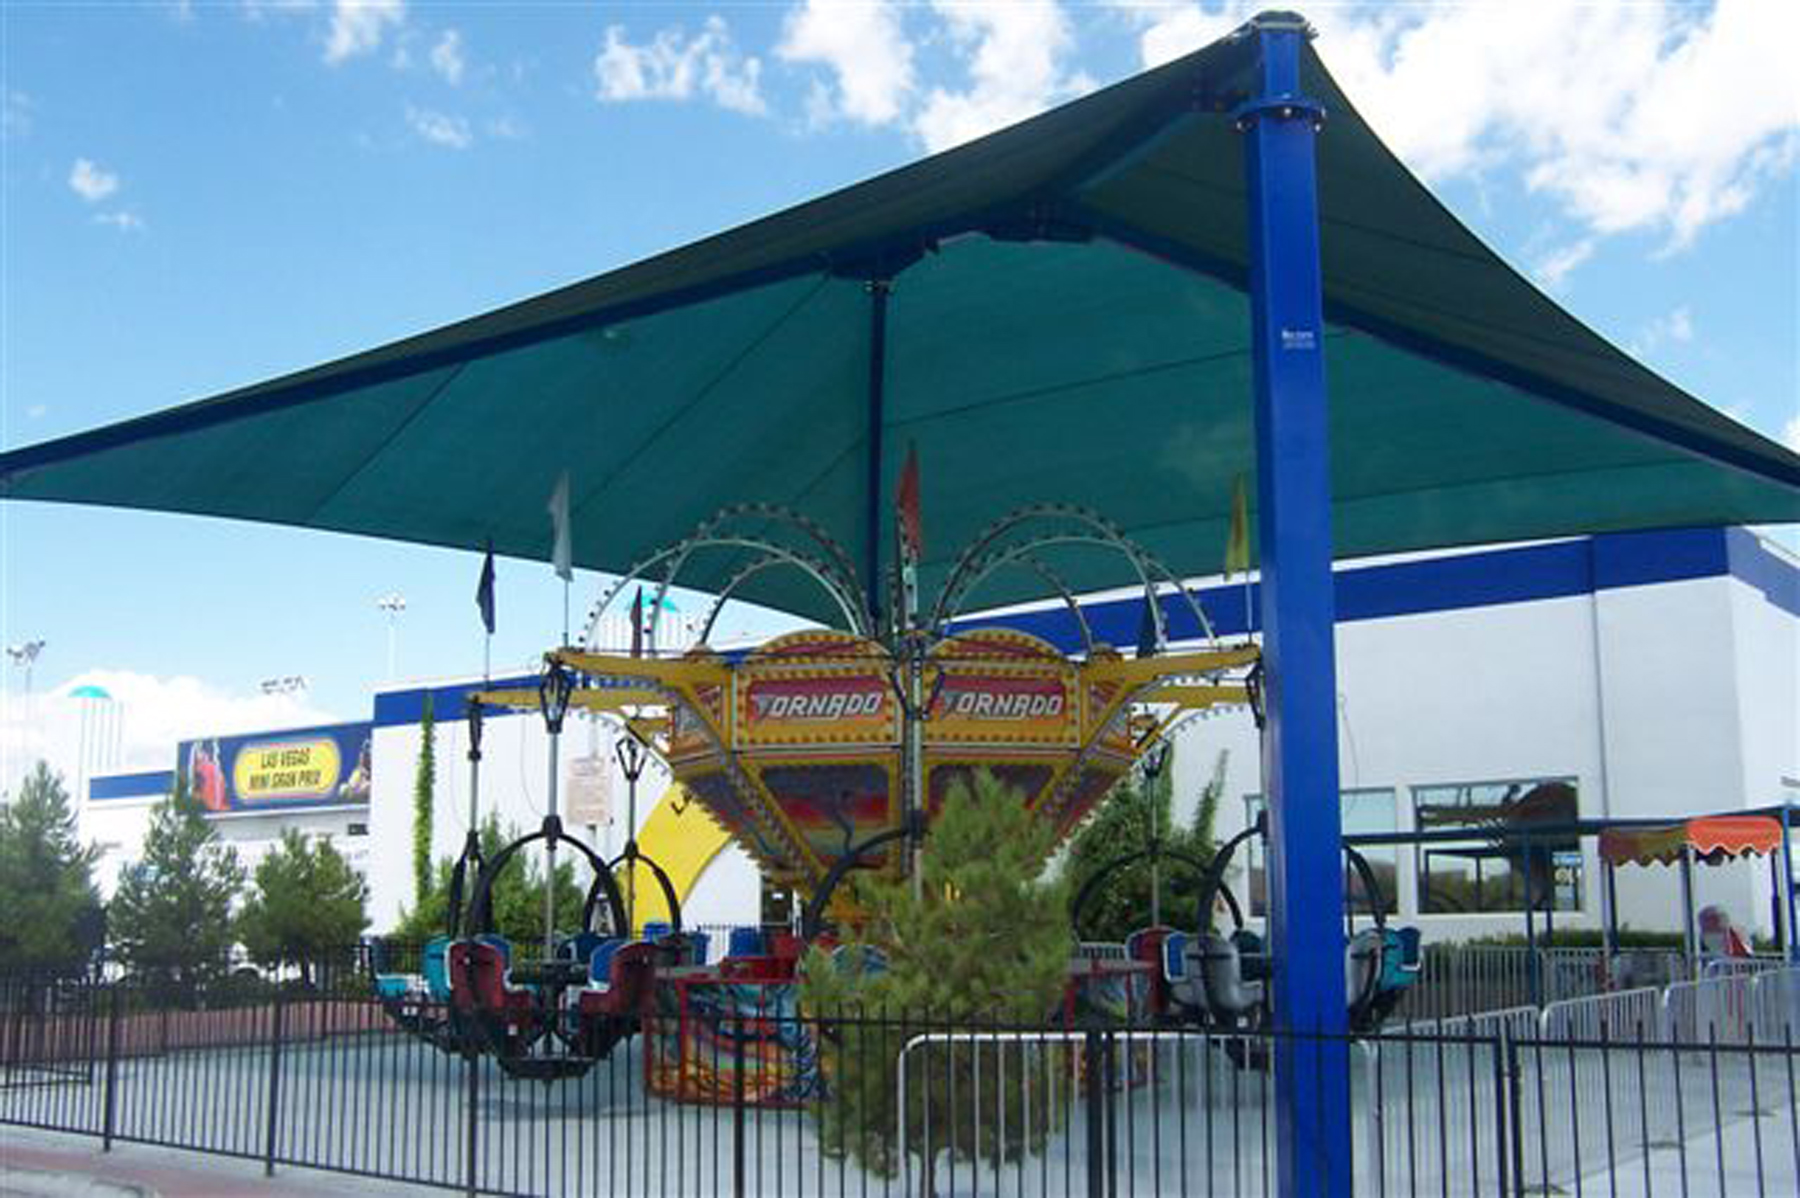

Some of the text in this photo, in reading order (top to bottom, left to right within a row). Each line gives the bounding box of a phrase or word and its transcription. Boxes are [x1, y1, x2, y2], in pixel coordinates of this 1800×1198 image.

[755, 692, 882, 720] TORNADO
[942, 692, 1064, 720] TORNADO
[260, 747, 310, 769] LAS VEGAS
[249, 769, 321, 790] MINI GRAN PRIX
